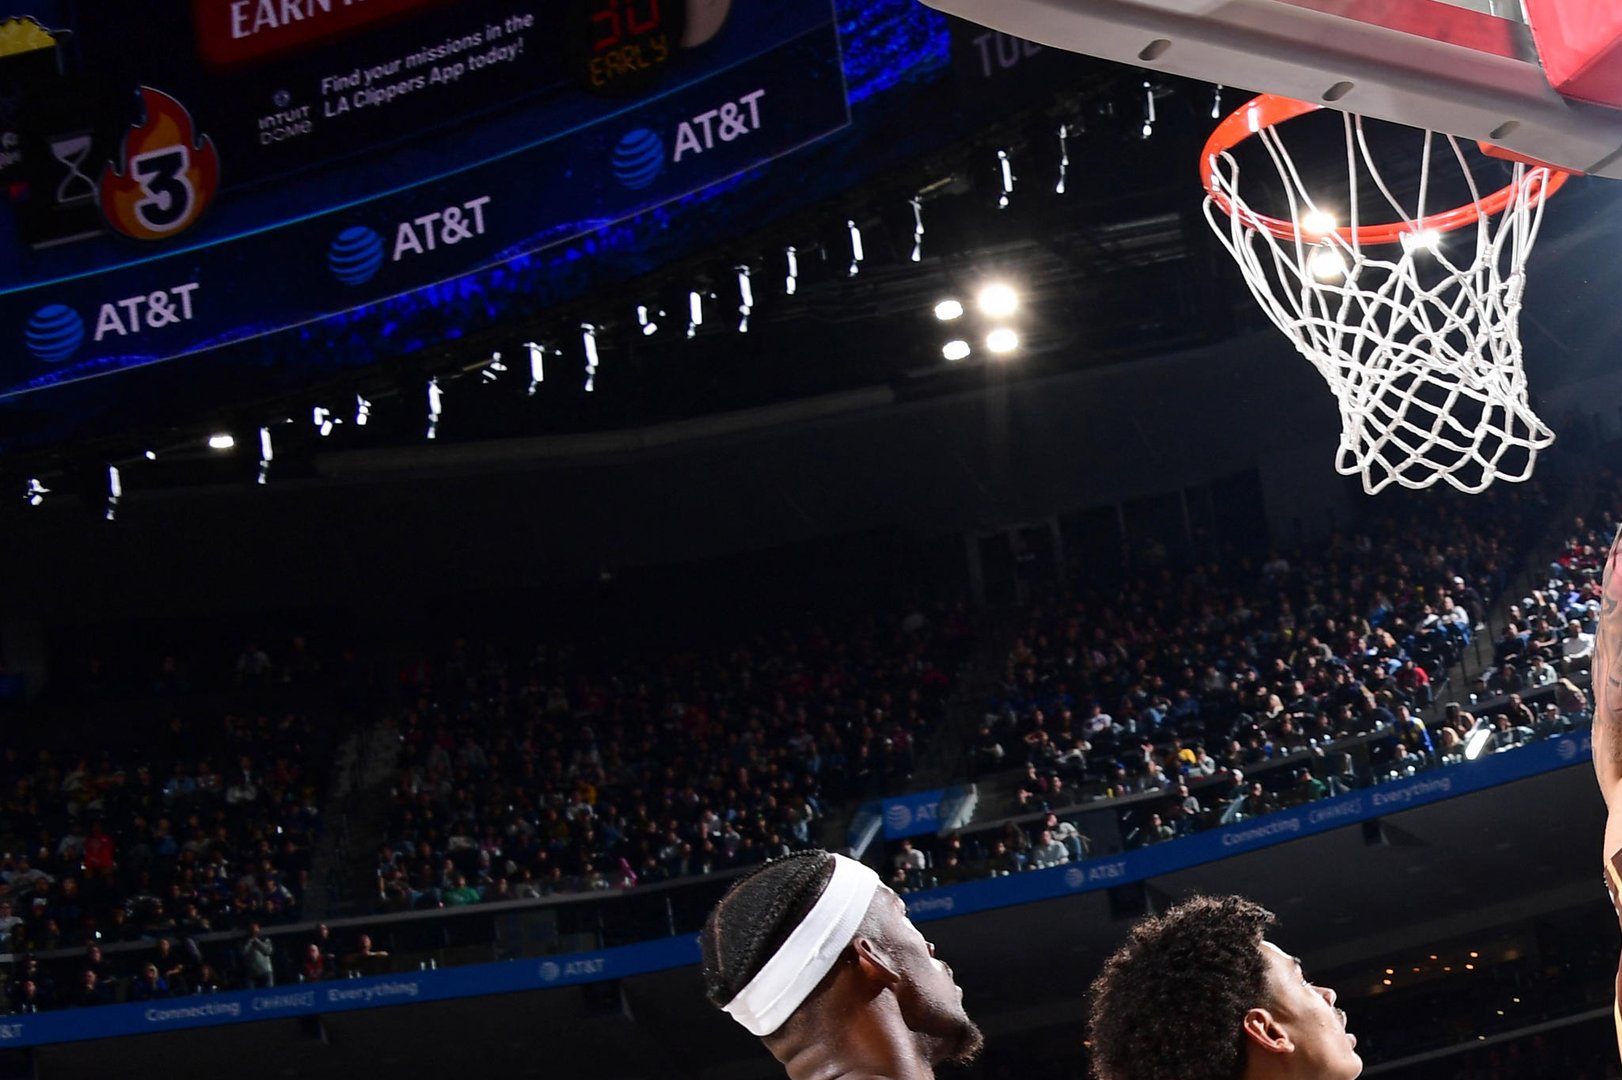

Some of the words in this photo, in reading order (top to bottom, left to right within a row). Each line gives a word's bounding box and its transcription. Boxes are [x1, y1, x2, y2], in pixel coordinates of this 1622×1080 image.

[321, 69, 360, 96] Find
[364, 59, 402, 87] your
[405, 31, 482, 68] missions
[485, 24, 502, 42] in
[505, 12, 535, 34] the
[324, 95, 350, 118] LA
[353, 74, 425, 109] Clippers
[429, 61, 464, 86] App
[468, 37, 524, 71] today!
[673, 89, 766, 163] AT&T
[131, 145, 191, 232] 3
[392, 197, 490, 262] AT&T
[94, 282, 200, 342] AT&T
[144, 1000, 241, 1023] Connecting
[327, 980, 418, 1002] Everything
